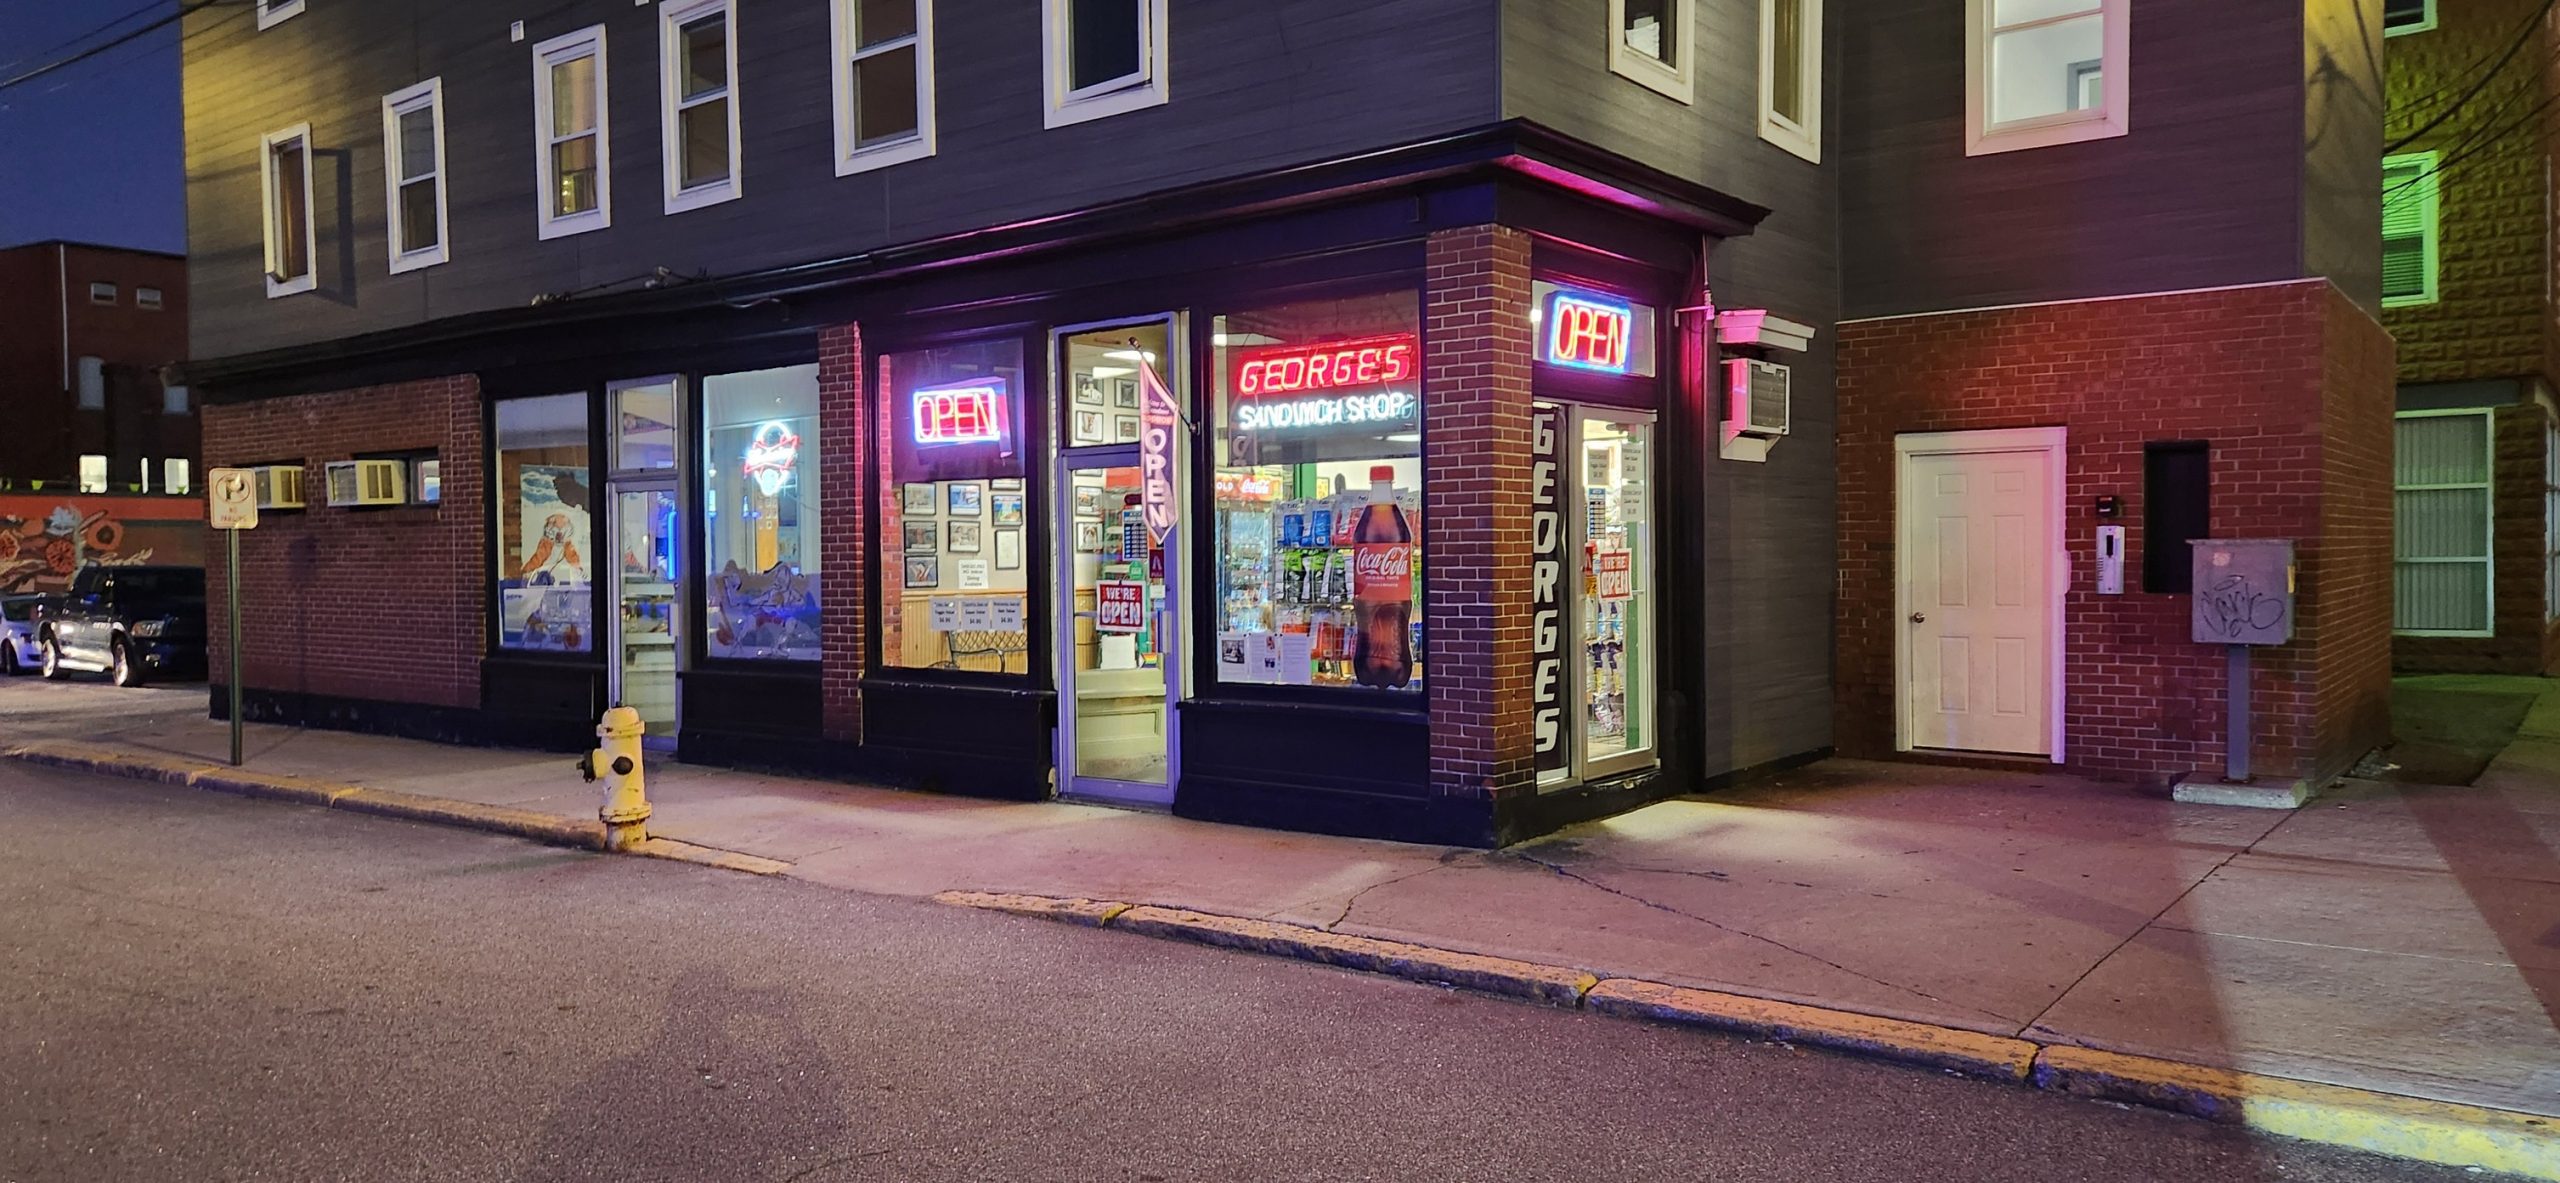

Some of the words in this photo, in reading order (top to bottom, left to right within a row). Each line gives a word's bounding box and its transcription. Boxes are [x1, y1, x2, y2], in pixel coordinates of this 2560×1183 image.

[1555, 303, 1627, 368] OPEN
[1240, 345, 1408, 394] GEORGE'S
[919, 391, 997, 440] OPEN
[1239, 398, 1342, 430] SANDWICH
[1345, 392, 1407, 422] SHOP
[1144, 428, 1169, 529] OPEN
[1215, 481, 1234, 493] OLD
[1356, 546, 1409, 576] Coca-Cola
[1106, 586, 1136, 601] WE'RE
[1601, 571, 1629, 597] OPEN
[1101, 600, 1141, 626] OPEN
